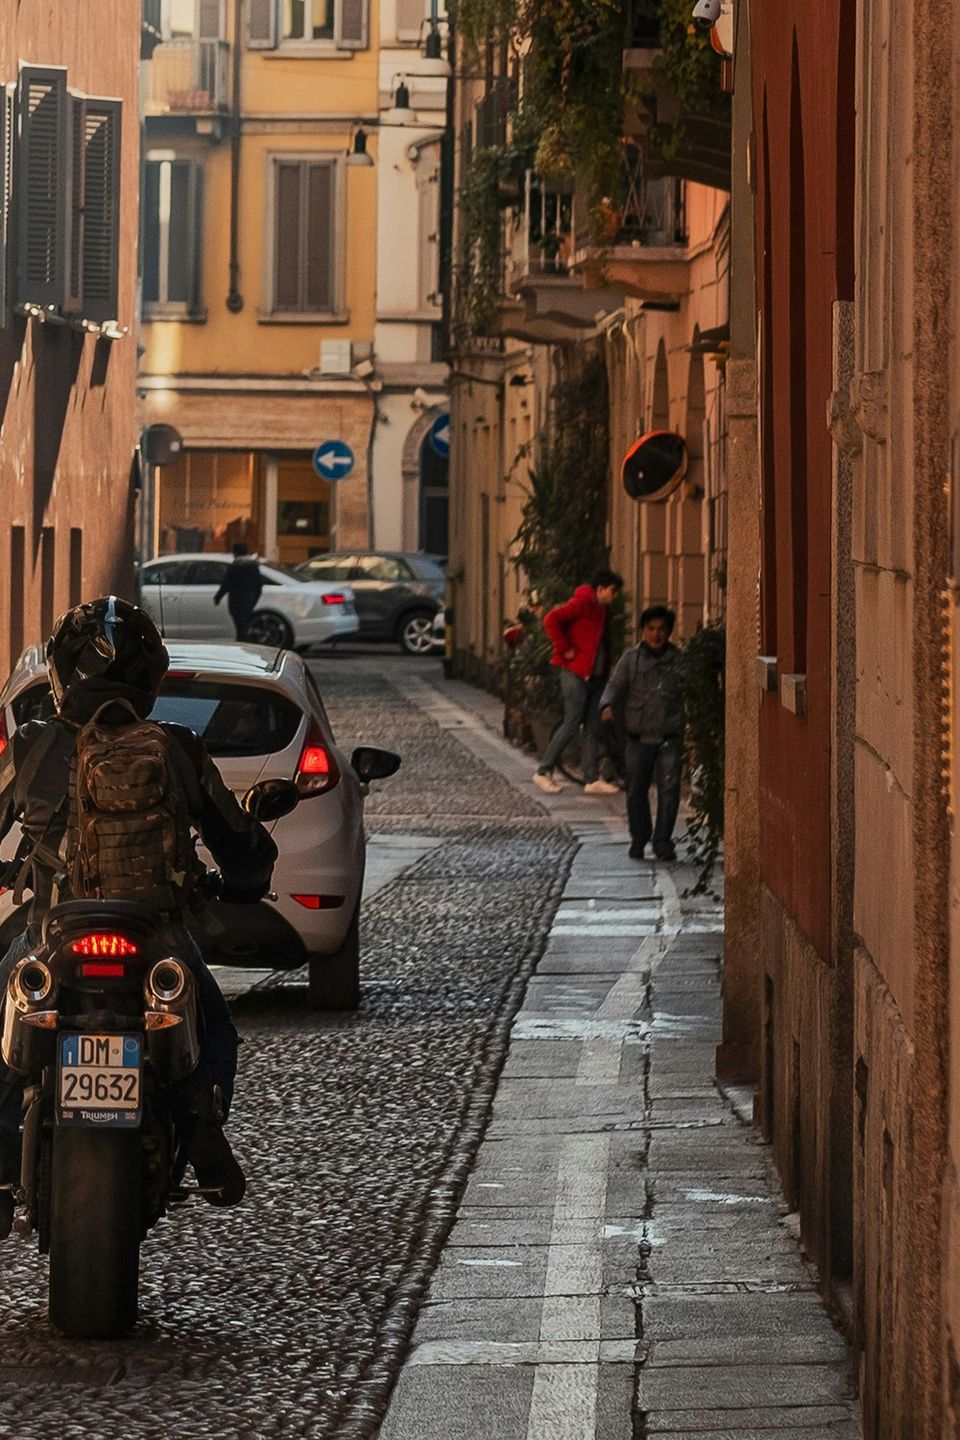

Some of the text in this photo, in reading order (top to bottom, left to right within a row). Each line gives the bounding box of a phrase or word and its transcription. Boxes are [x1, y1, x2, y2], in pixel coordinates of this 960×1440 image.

[80, 1037, 110, 1065] DM
[64, 1073, 138, 1101] 29632
[80, 1110, 118, 1120] TRIUMPH
